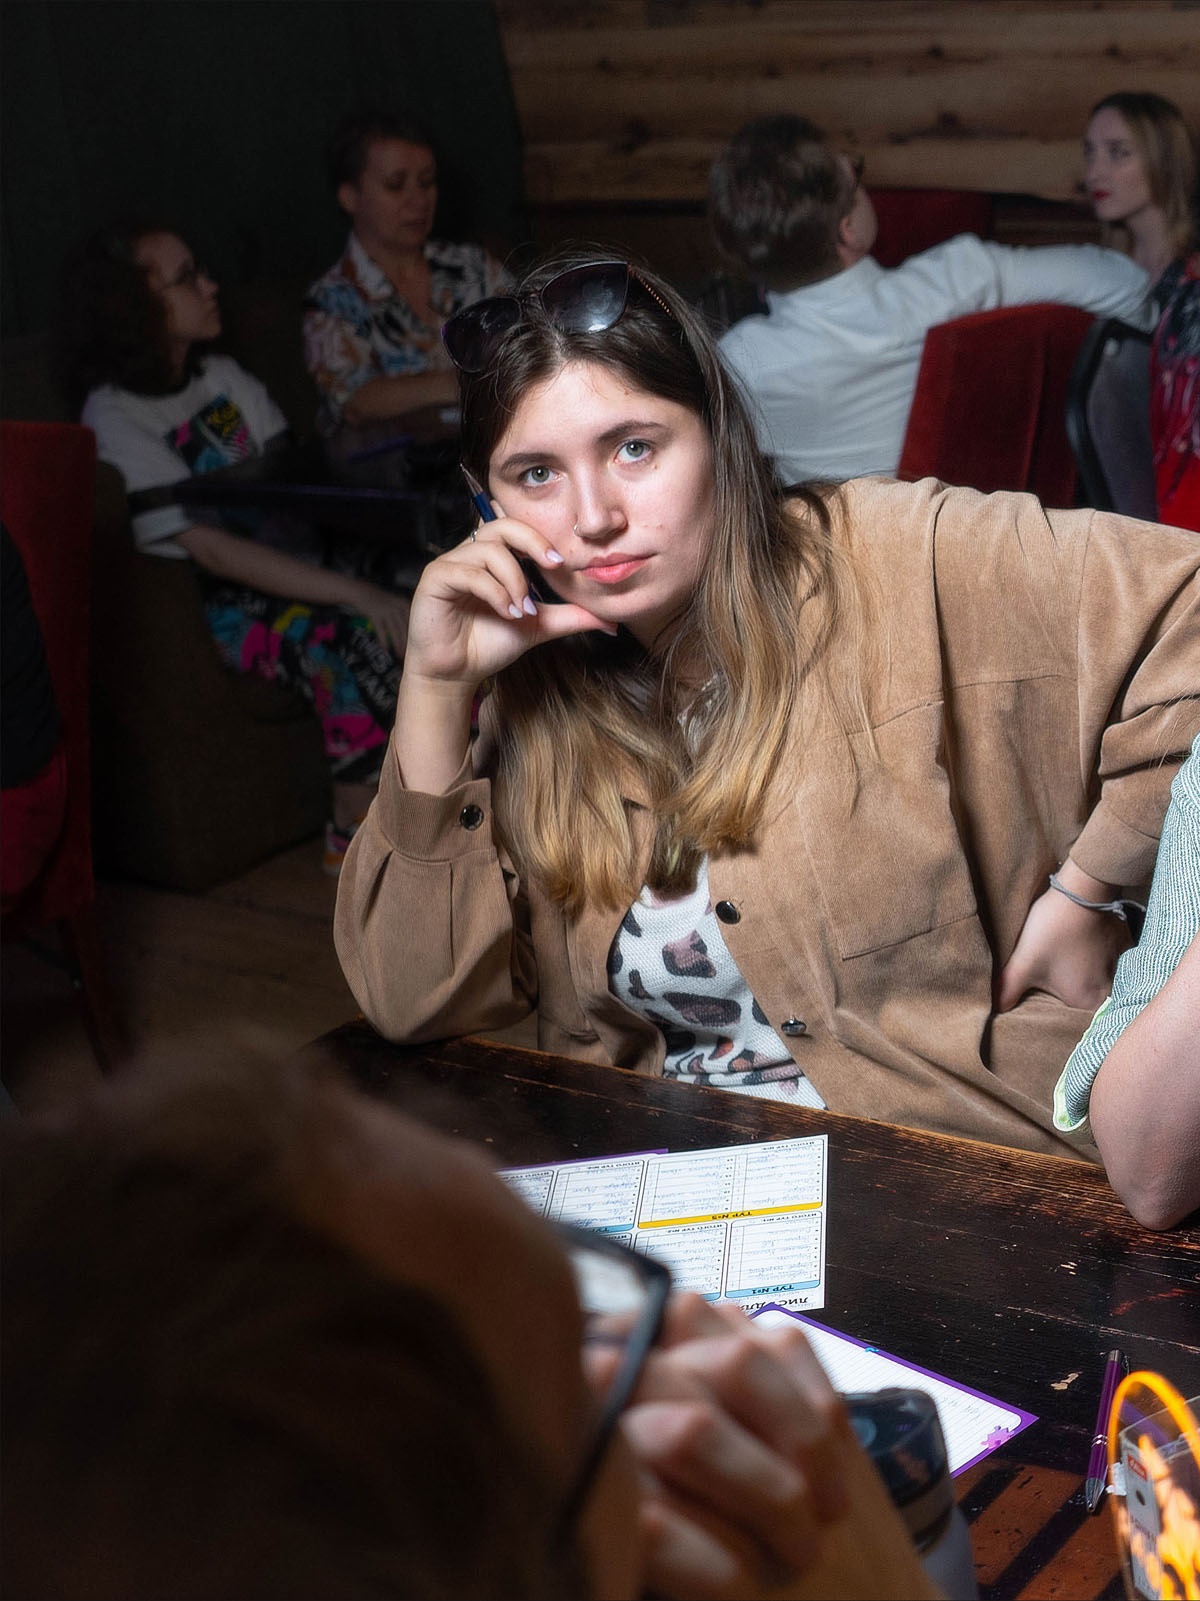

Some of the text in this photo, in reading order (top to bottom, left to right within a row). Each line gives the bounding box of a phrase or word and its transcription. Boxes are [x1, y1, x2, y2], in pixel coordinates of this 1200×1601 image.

[751, 1287, 770, 1295] №1
[772, 1284, 795, 1292] ТУР
[774, 1296, 809, 1306] ЛИС
